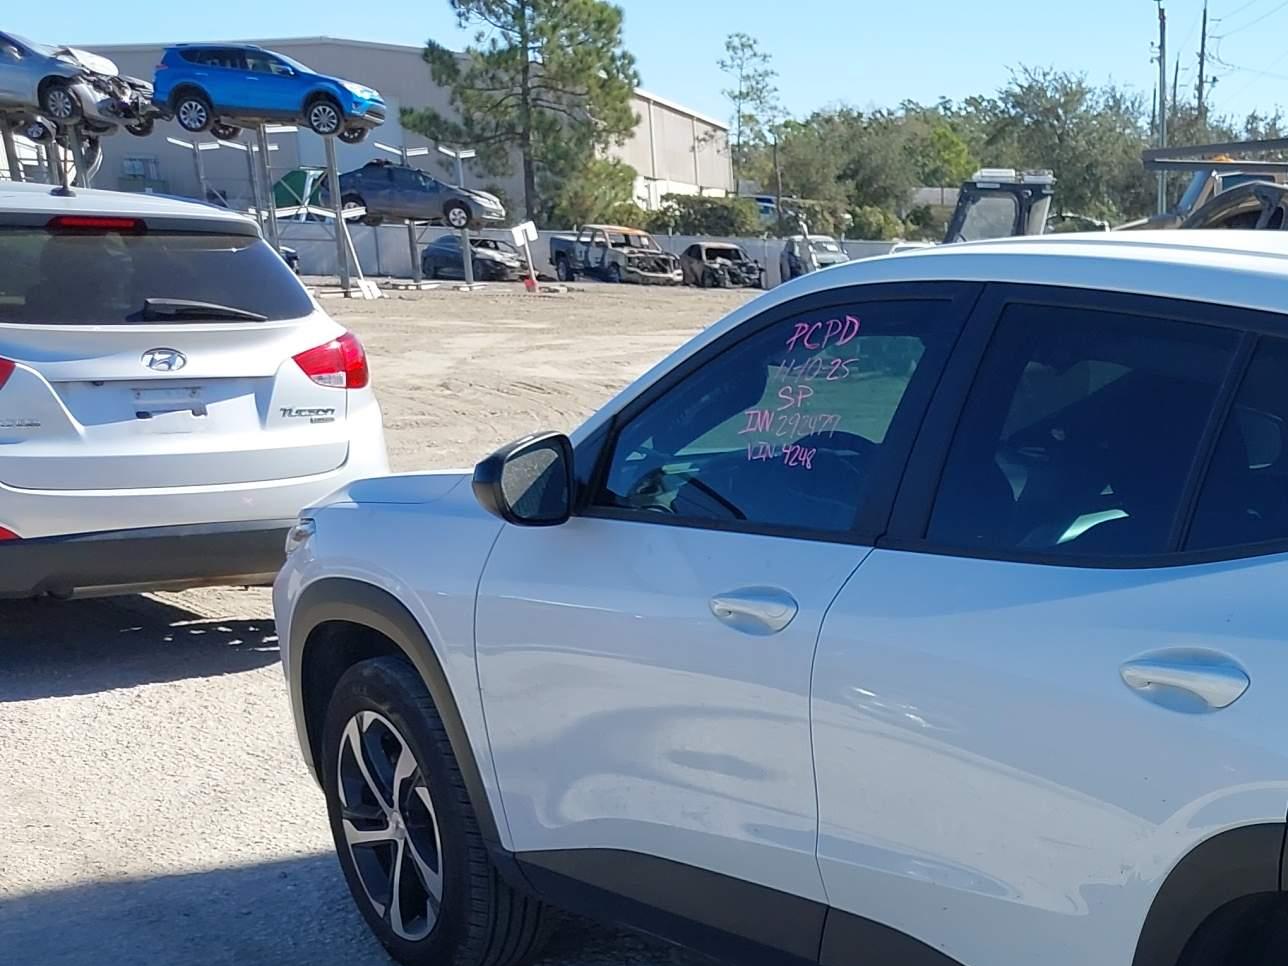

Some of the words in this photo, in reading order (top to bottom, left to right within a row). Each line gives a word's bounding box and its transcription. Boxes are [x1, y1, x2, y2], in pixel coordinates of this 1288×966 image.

[786, 315, 860, 351] PCPD
[777, 385, 814, 411] SP
[781, 443, 817, 470] 4248
